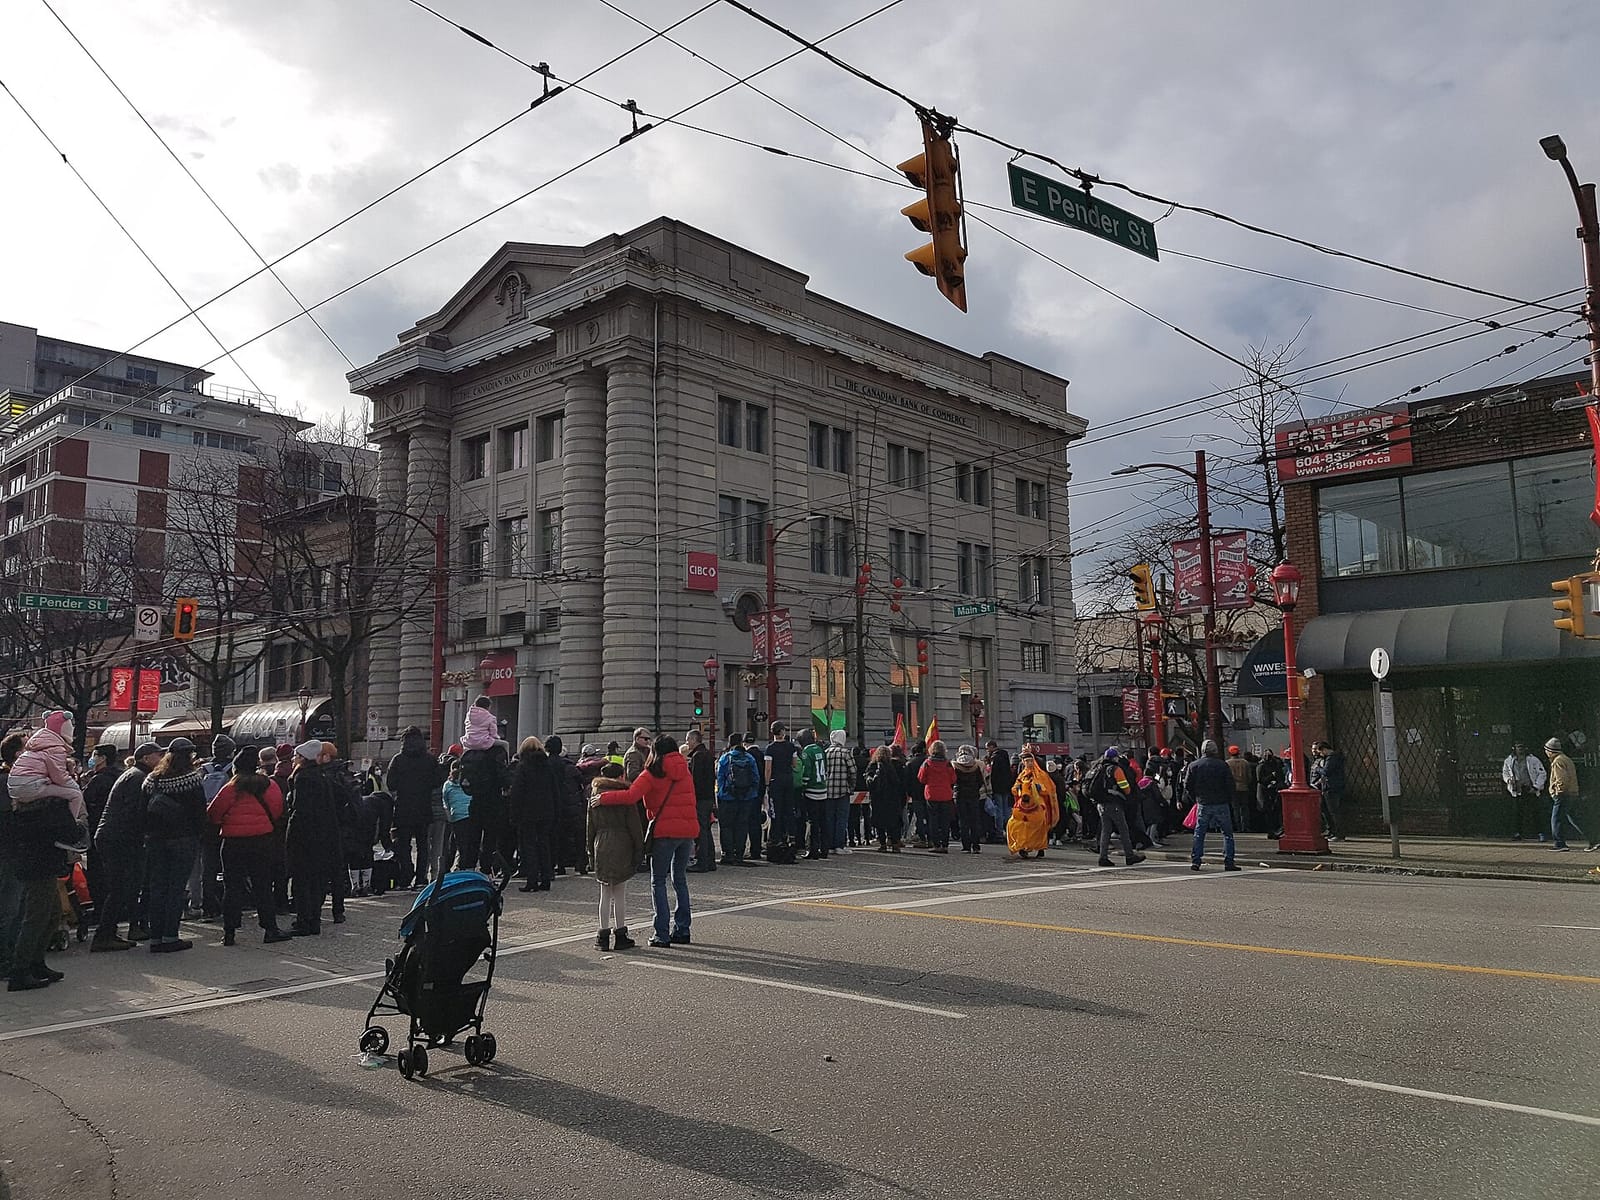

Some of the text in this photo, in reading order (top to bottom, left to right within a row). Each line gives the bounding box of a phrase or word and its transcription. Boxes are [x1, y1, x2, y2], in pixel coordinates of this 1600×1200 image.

[1021, 176, 1149, 249] E Pender St
[473, 378, 502, 396] CANADIAN
[504, 371, 522, 385] BANK
[523, 365, 532, 378] OF
[845, 379, 967, 426] THE CANADIAN BANK OF COMMERCE
[1332, 415, 1394, 439] LEASE
[689, 565, 708, 576] CIBC
[25, 595, 102, 610] E Pender St
[957, 603, 991, 616] Main St
[1253, 662, 1287, 672] WAVES
